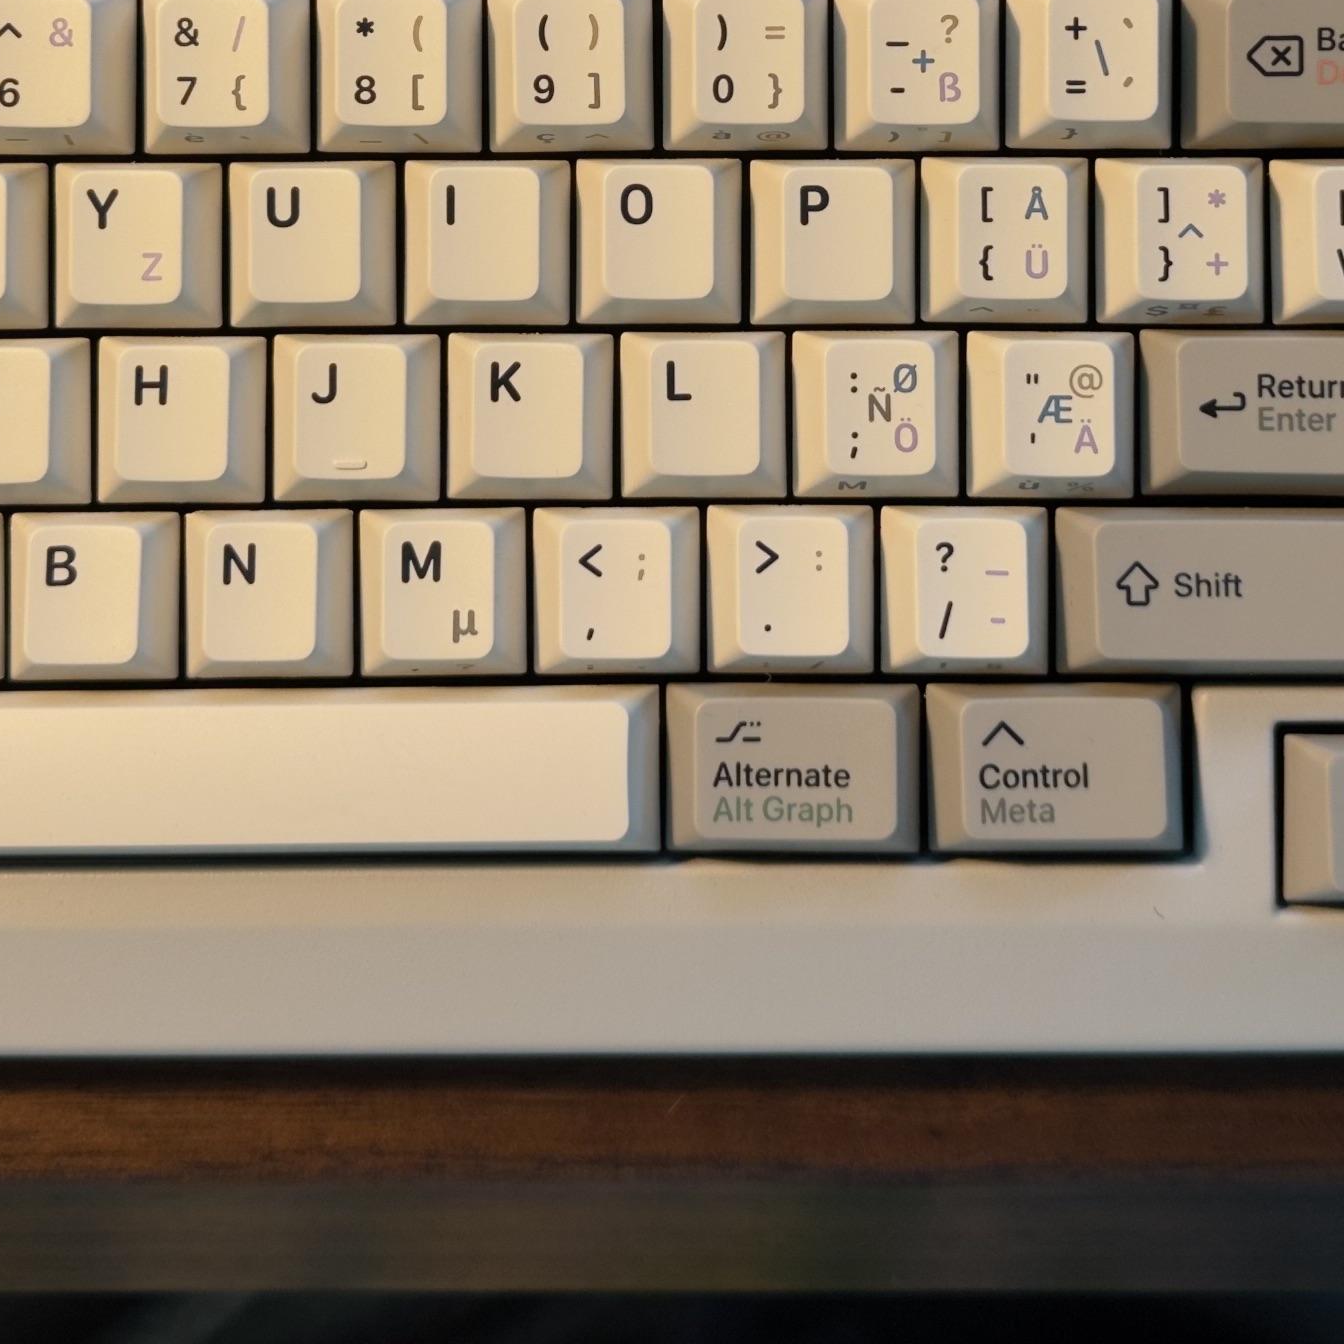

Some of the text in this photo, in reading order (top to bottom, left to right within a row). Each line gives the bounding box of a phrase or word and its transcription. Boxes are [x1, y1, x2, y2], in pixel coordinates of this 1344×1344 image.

[49, 18, 73, 47] &
[174, 17, 199, 47] &
[940, 14, 959, 44] ?
[177, 76, 197, 105] 7
[354, 75, 376, 105] 8
[533, 74, 555, 104] 9
[87, 189, 118, 229] Y
[267, 187, 300, 228] U
[800, 185, 829, 226] P
[141, 253, 162, 282] Z
[1025, 244, 1049, 279] Ü
[134, 365, 168, 406] H
[311, 363, 337, 404] J
[490, 362, 521, 402] K
[666, 361, 692, 401] L
[1069, 364, 1103, 400] @
[895, 418, 918, 453] Ö
[1258, 406, 1337, 432] Enter
[1074, 419, 1099, 454] Ä
[45, 545, 77, 587] B
[223, 543, 256, 585] N
[401, 541, 441, 583] M
[936, 542, 954, 572] ?
[1174, 572, 1242, 598] Shift
[713, 762, 850, 788] Alternate
[979, 762, 1088, 790] Control
[713, 795, 853, 828] Alt Graph
[981, 797, 1055, 825] Meta
